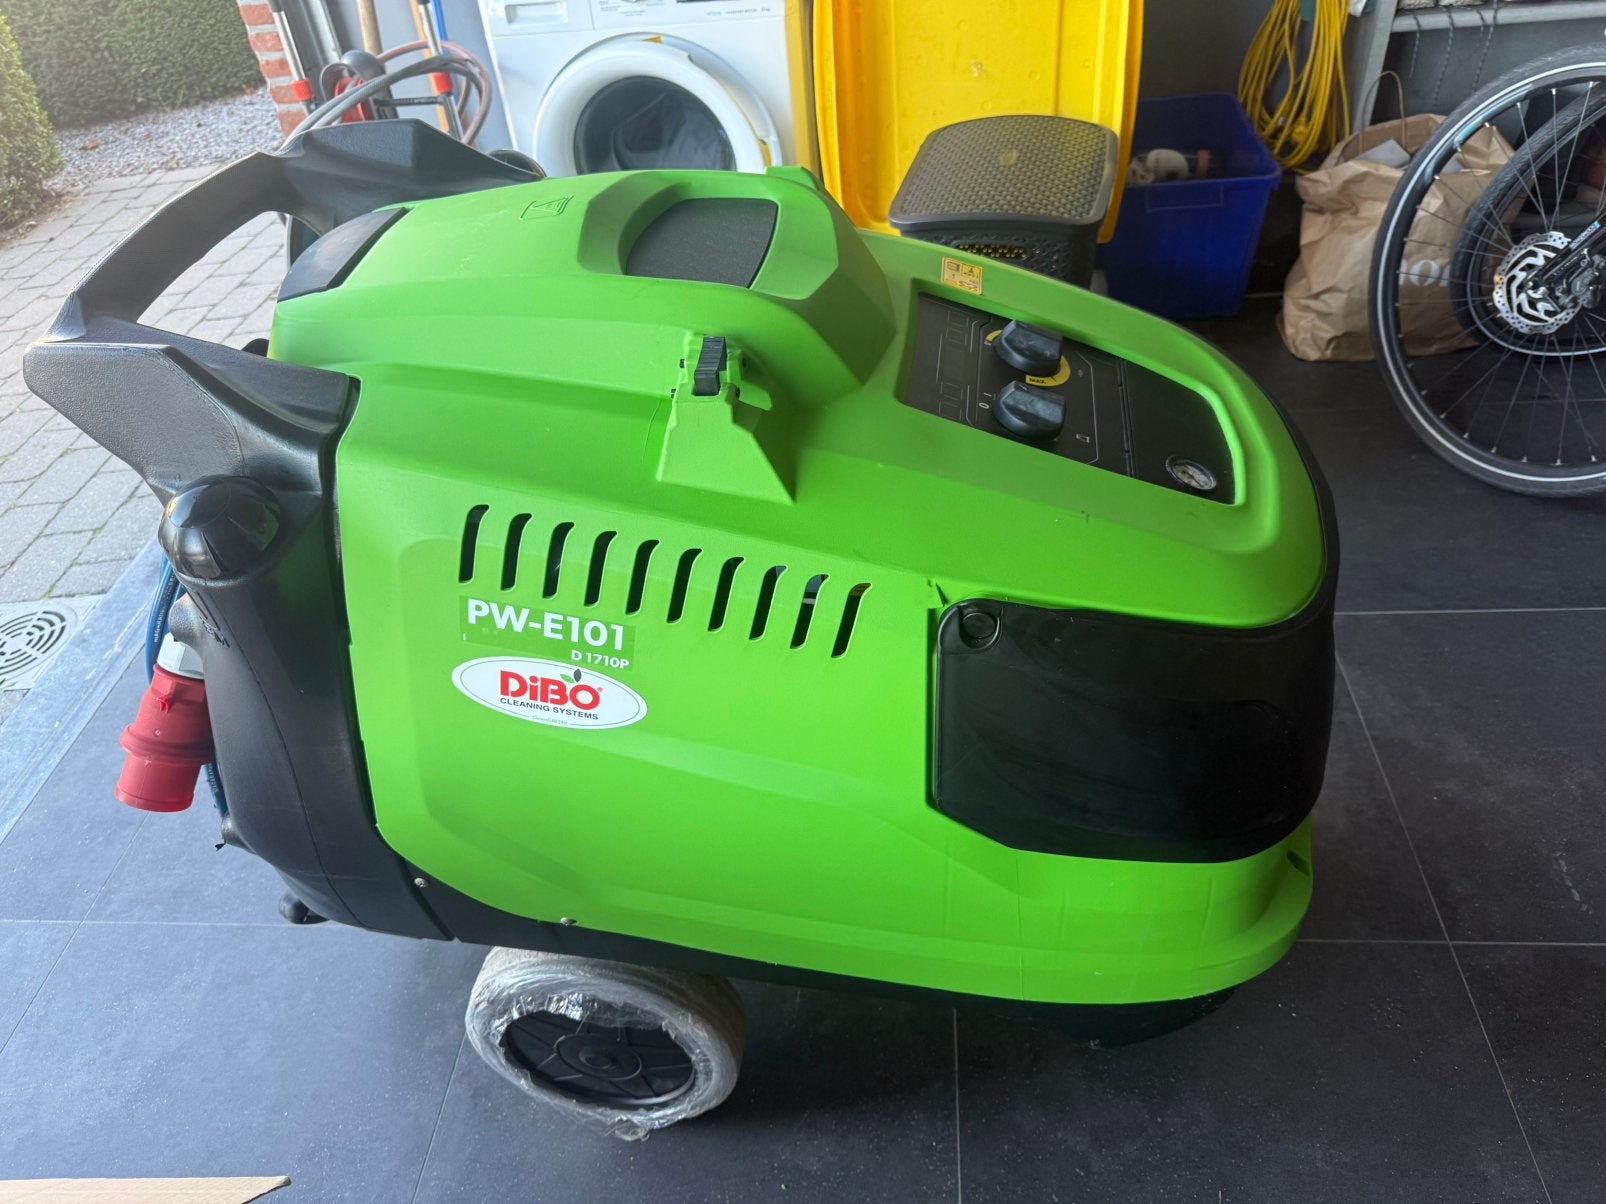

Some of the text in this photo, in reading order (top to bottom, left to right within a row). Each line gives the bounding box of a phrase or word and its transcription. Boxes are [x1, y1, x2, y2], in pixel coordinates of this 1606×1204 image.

[467, 598, 624, 651] PW-E101
[586, 652, 630, 670] 1710P
[499, 697, 599, 720] CLEANING SYSTEMS
